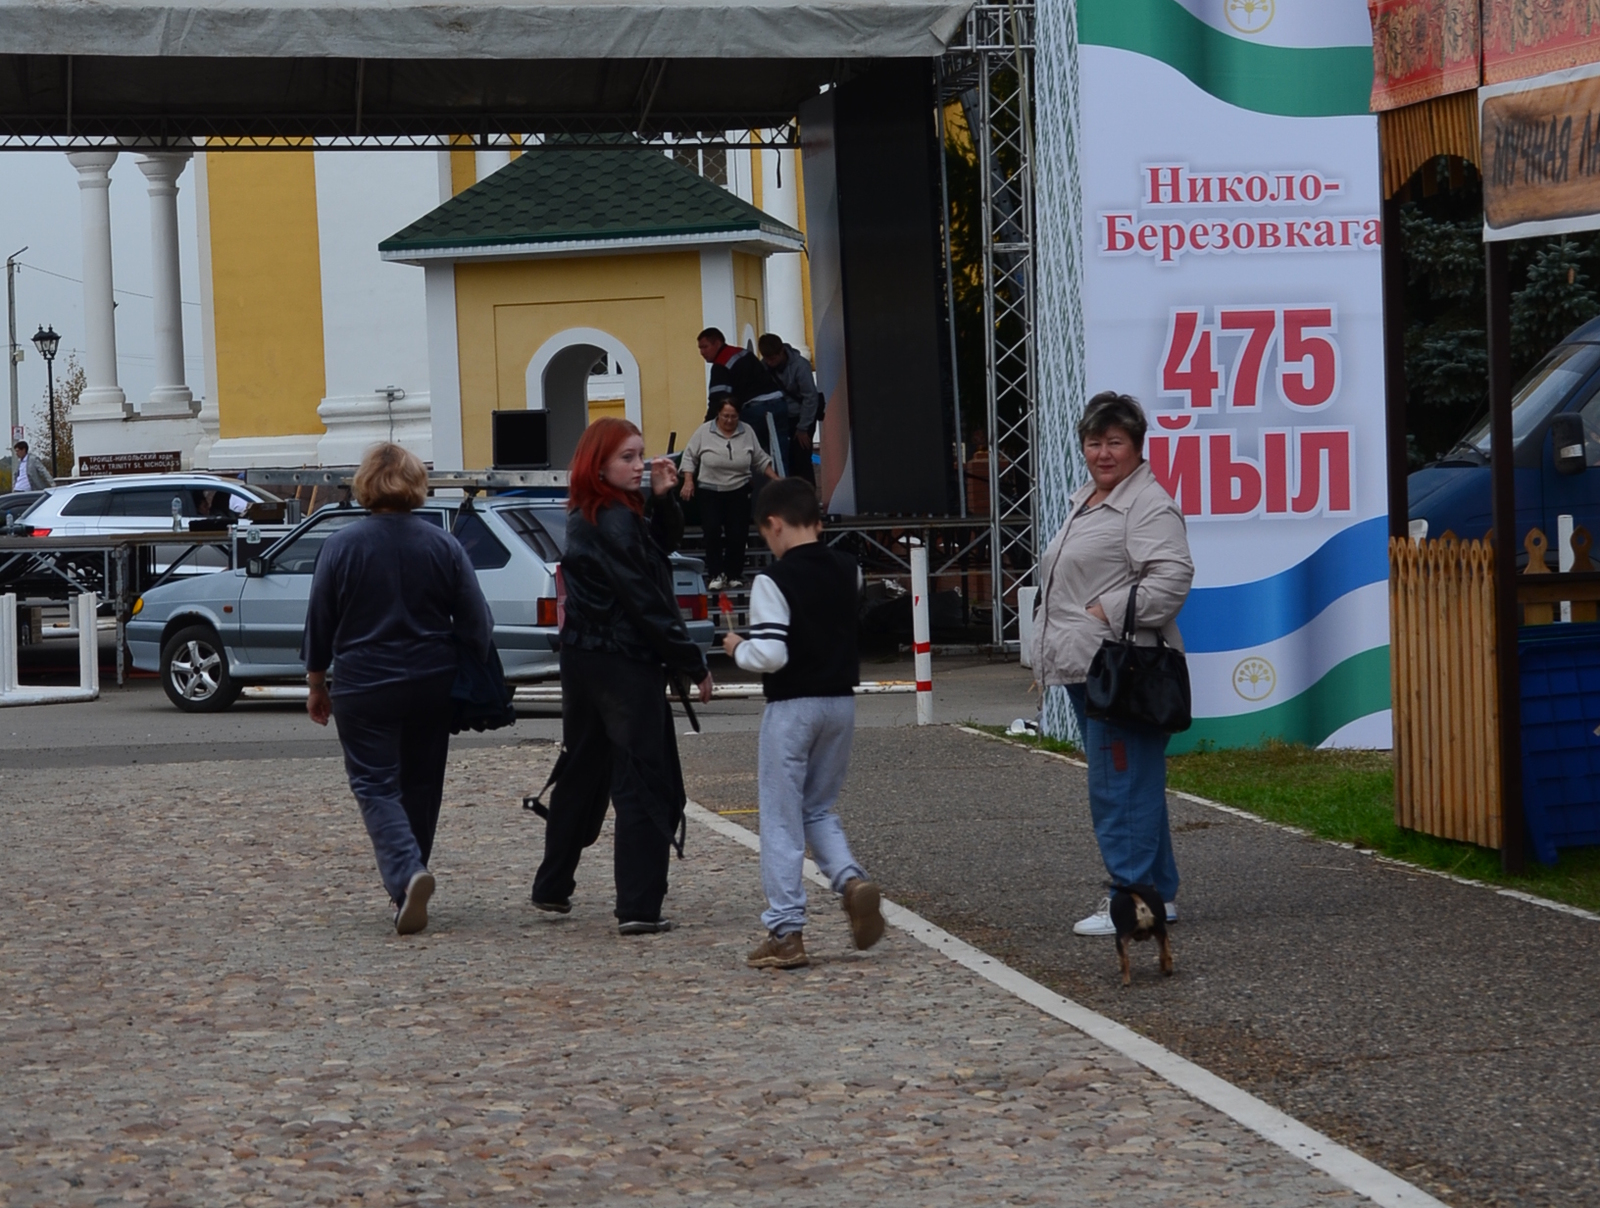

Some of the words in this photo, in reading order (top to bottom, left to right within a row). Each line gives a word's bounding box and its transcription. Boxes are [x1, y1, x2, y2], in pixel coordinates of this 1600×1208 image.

[1146, 166, 1340, 204] Николо-
[1102, 213, 1382, 262] Березовкага
[1163, 308, 1335, 407] 475
[89, 454, 156, 463] ТРОИЦЕ-НИКОЛЬСКИЙ
[89, 463, 105, 471] HOLY
[1148, 415, 1351, 515] ЙЫЛ
